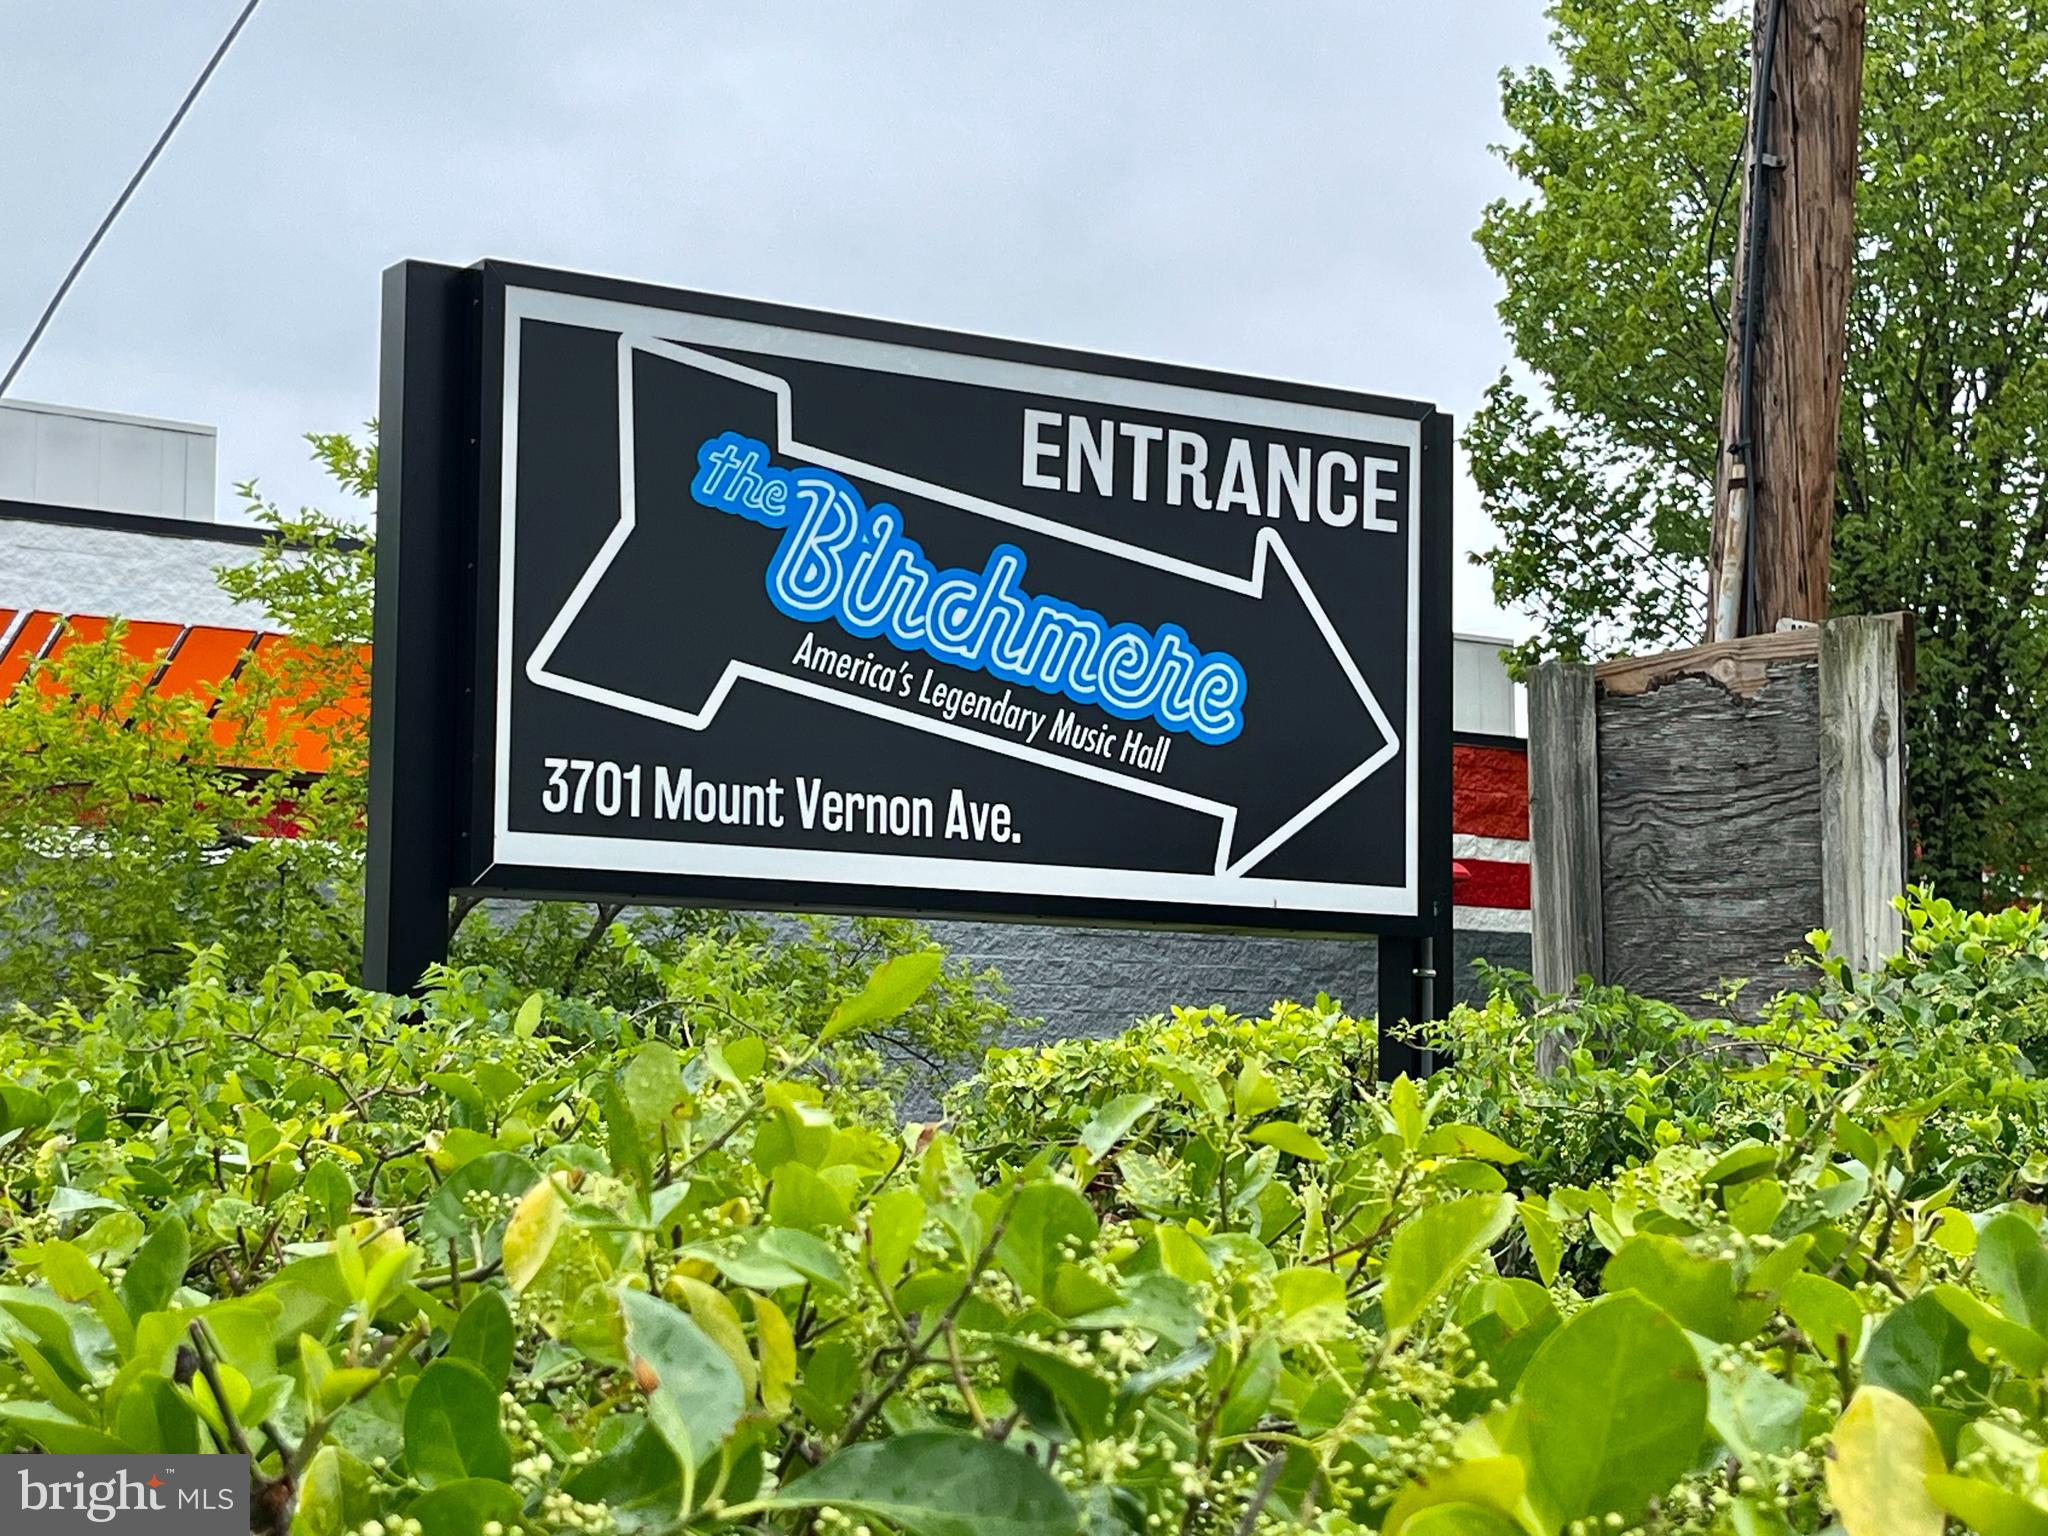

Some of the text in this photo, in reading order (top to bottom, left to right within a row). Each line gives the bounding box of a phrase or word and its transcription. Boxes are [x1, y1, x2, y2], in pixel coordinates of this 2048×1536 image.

[1022, 408, 1399, 533] ENTRANCE
[702, 444, 1239, 735] the Birchmere
[791, 632, 1172, 774] America's Legendary Music Hall
[542, 757, 1021, 844] 3701 Mount Vernon Ave.
